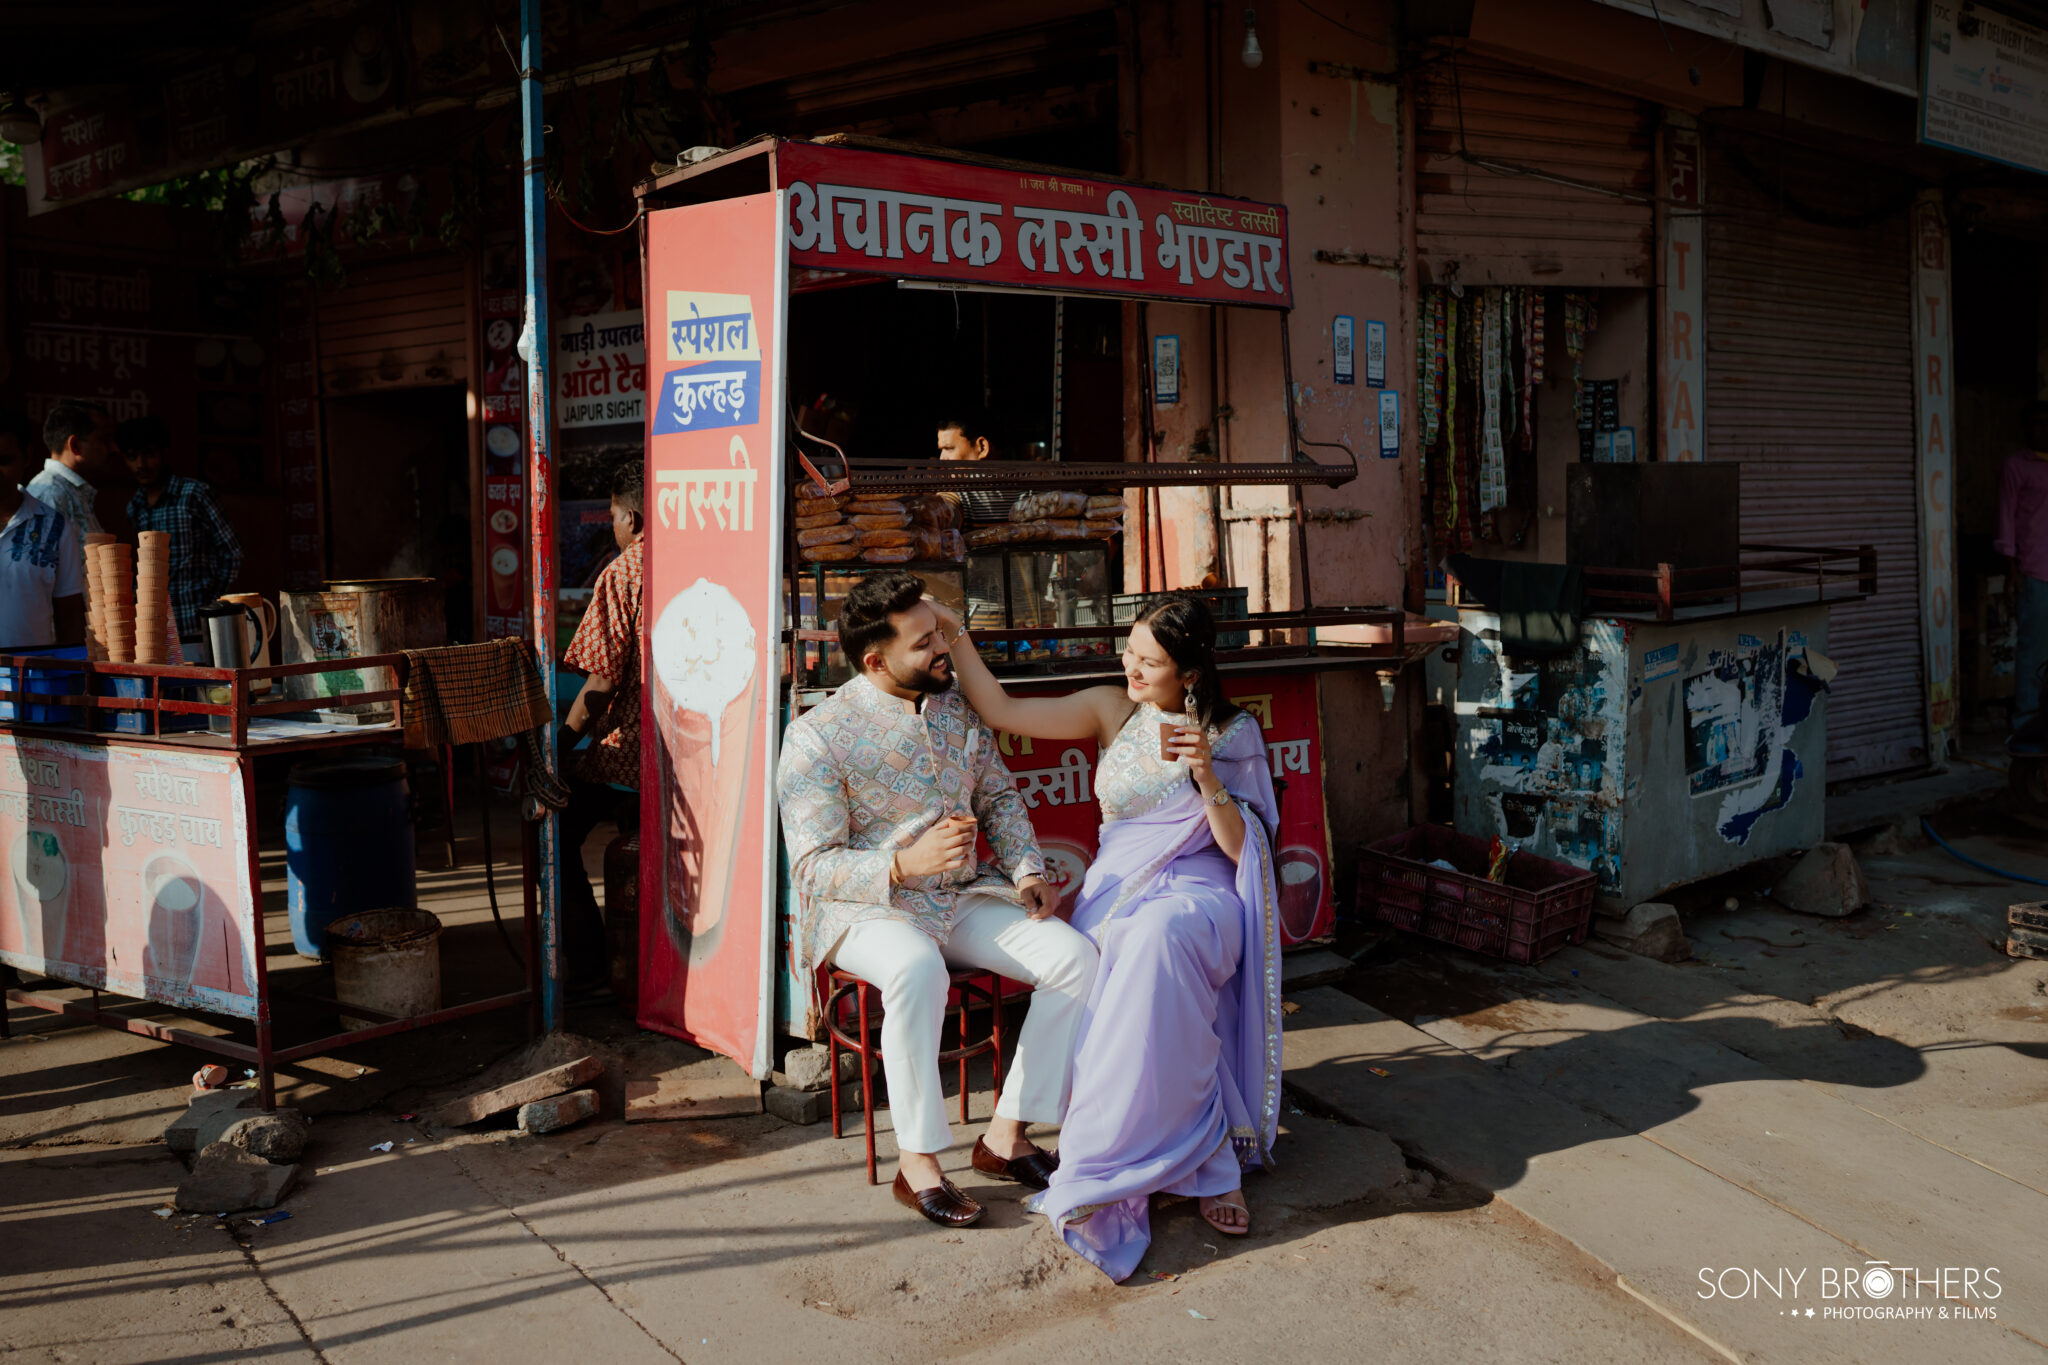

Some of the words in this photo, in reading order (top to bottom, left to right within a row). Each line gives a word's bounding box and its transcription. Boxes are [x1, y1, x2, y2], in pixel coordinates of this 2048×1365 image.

[1029, 179, 1045, 191] जय
[788, 181, 1002, 267] अचानक
[1013, 189, 1145, 281] लस्सी
[1156, 213, 1285, 295] भण्डार
[1171, 197, 1233, 227] स्वादिष्ट
[1238, 207, 1280, 235] लस्सी
[560, 322, 595, 356] गाड़ी
[597, 324, 644, 348] उपलब्
[671, 302, 751, 356] स्पेशल
[1672, 241, 1695, 462] TRA
[561, 356, 612, 398] ऑटो
[673, 370, 747, 425] कुल्हड़
[564, 403, 604, 423] JAIPUR
[606, 399, 642, 419] SIGHT
[656, 433, 758, 532] लस्सी
[1926, 296, 1948, 680] TRACKON
[5, 754, 61, 788] स्पेशल
[134, 761, 200, 806] स्पेशल
[1015, 748, 1092, 809] स्सी
[38, 788, 87, 827] लस्सी
[117, 805, 177, 847] कुल्हड़
[180, 814, 223, 848] चाय
